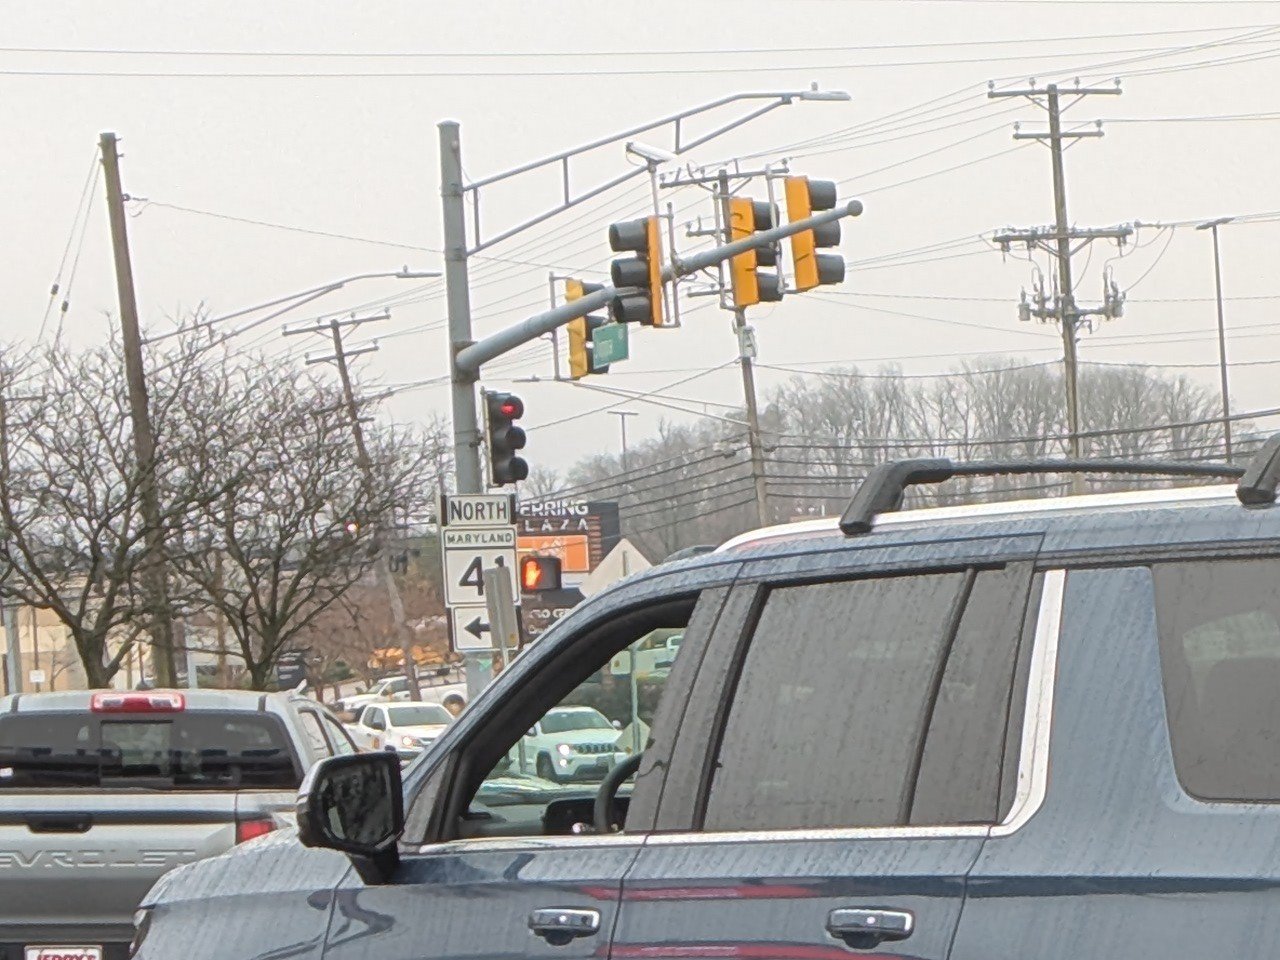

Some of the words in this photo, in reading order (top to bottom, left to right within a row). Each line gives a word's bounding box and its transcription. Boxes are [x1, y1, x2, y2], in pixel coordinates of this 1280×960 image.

[450, 501, 507, 521] NORTH
[515, 499, 589, 516] ERRING
[446, 532, 513, 545] MARYLAND
